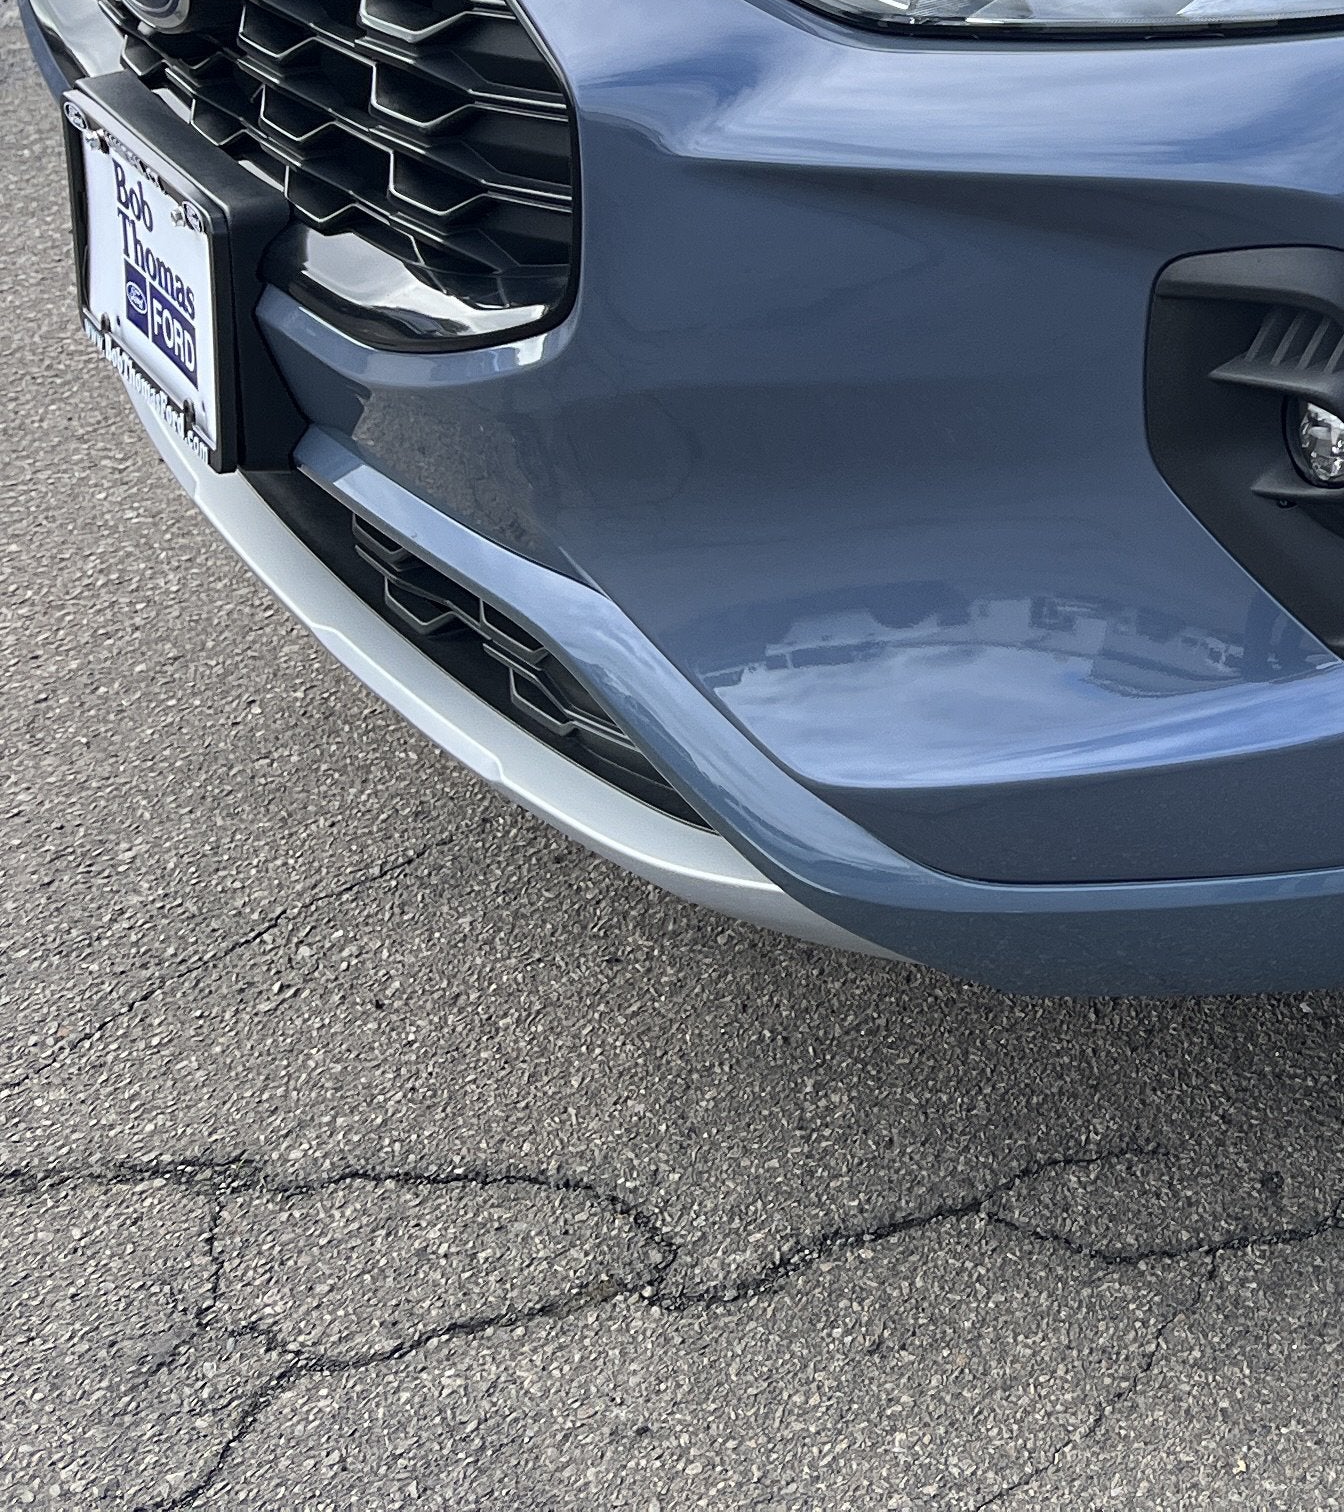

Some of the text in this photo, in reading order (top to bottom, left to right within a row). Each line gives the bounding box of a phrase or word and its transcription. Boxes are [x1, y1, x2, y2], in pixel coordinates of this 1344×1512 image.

[112, 157, 154, 232] Bob
[117, 206, 195, 320] Thomas
[152, 297, 195, 372] FORD
